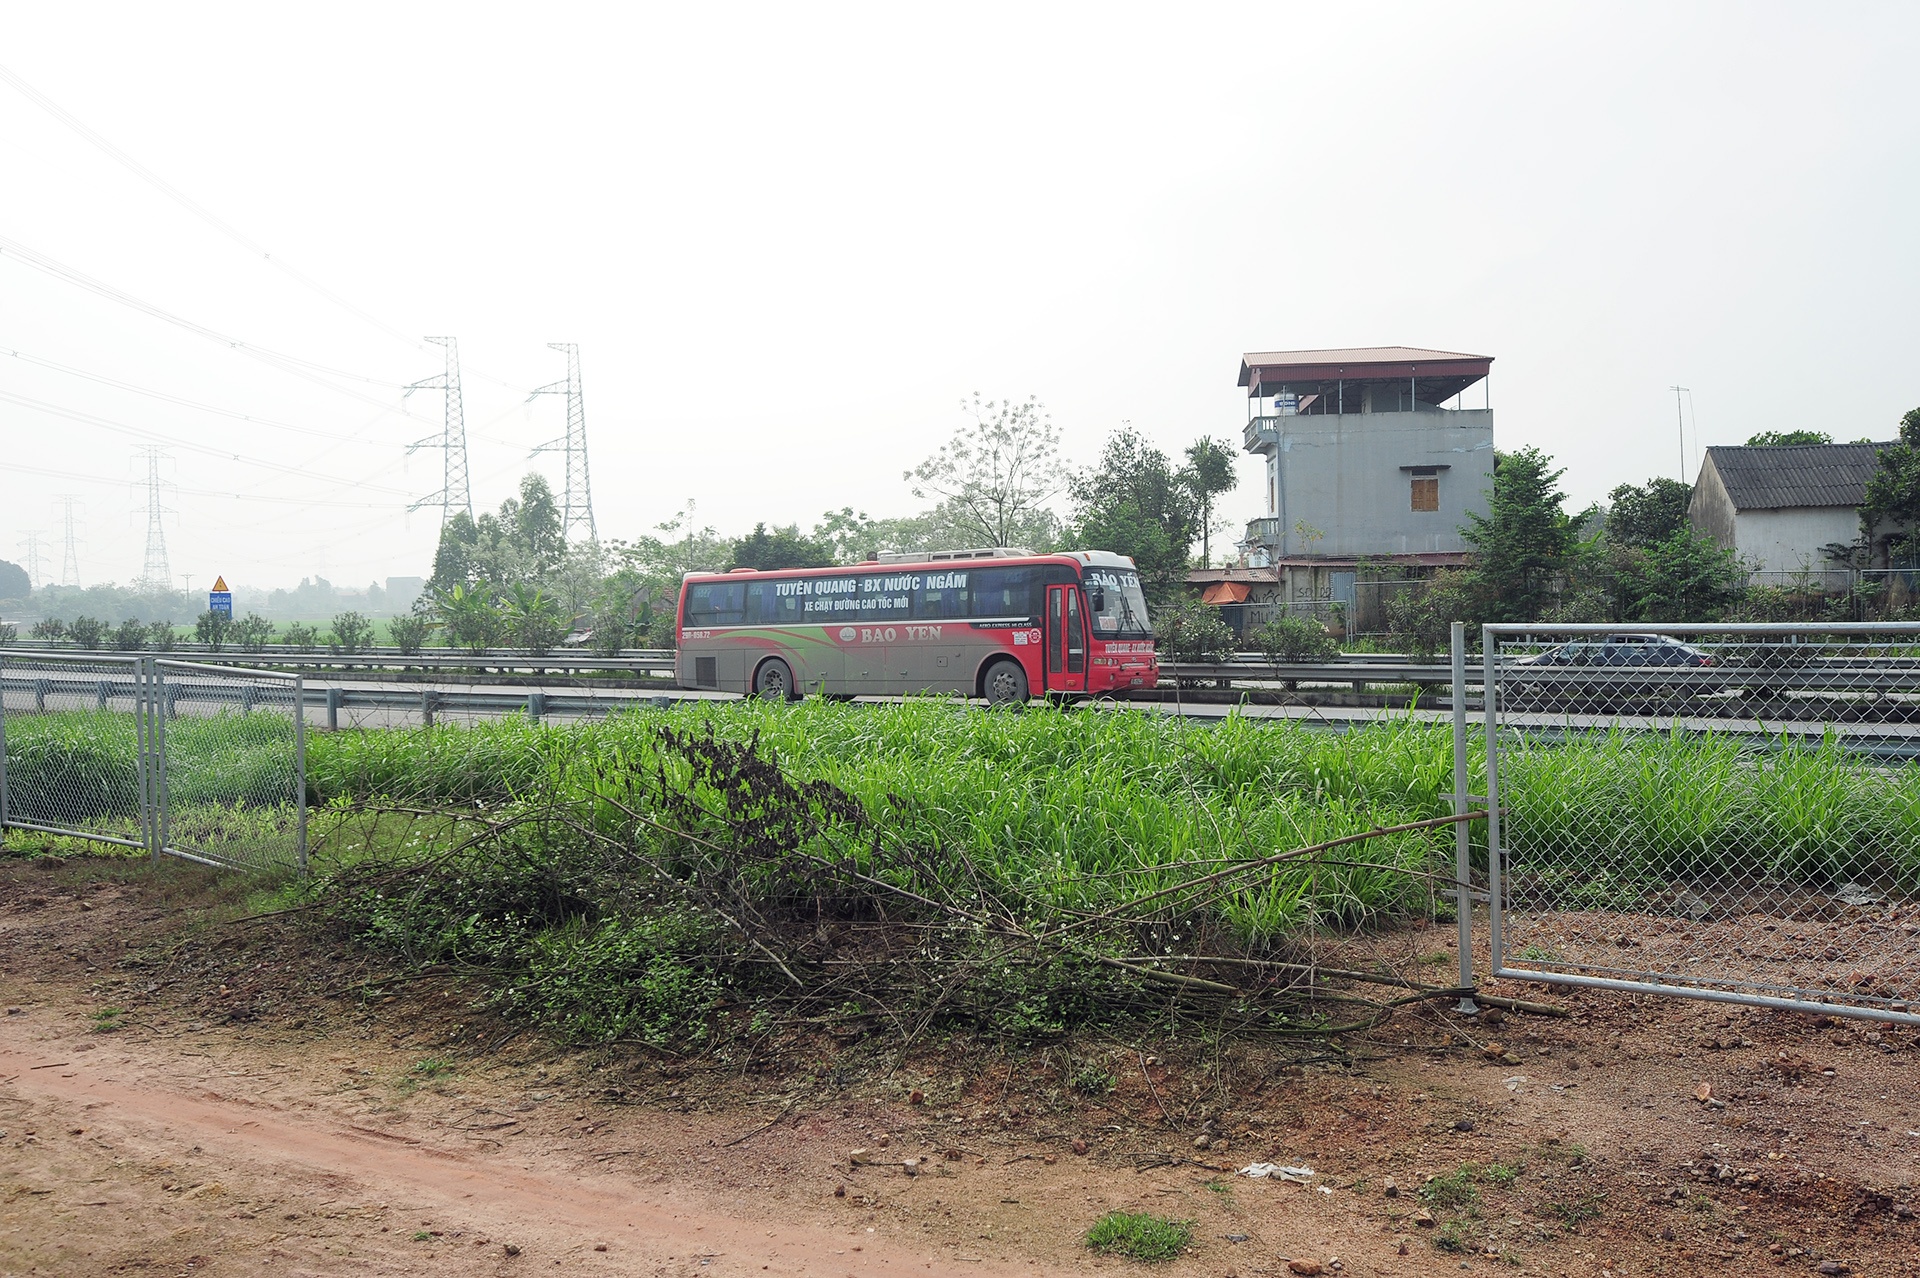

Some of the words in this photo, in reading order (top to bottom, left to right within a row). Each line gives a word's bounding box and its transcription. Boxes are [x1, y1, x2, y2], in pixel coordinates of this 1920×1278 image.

[776, 580, 812, 596] TUYÊN
[815, 579, 856, 595] QUANG
[864, 578, 881, 592] BX
[884, 574, 920, 591] NƯỚC
[926, 572, 967, 589] NGẦM
[1091, 569, 1117, 586] BẢO
[804, 601, 813, 611] XE
[815, 600, 833, 612] CHẠY
[834, 598, 860, 610] ĐƯỜNG
[861, 599, 876, 609] CAO
[878, 595, 892, 609] TỐC
[894, 595, 909, 608] MỚI
[861, 628, 896, 643] BAO
[905, 626, 942, 640] YEN
